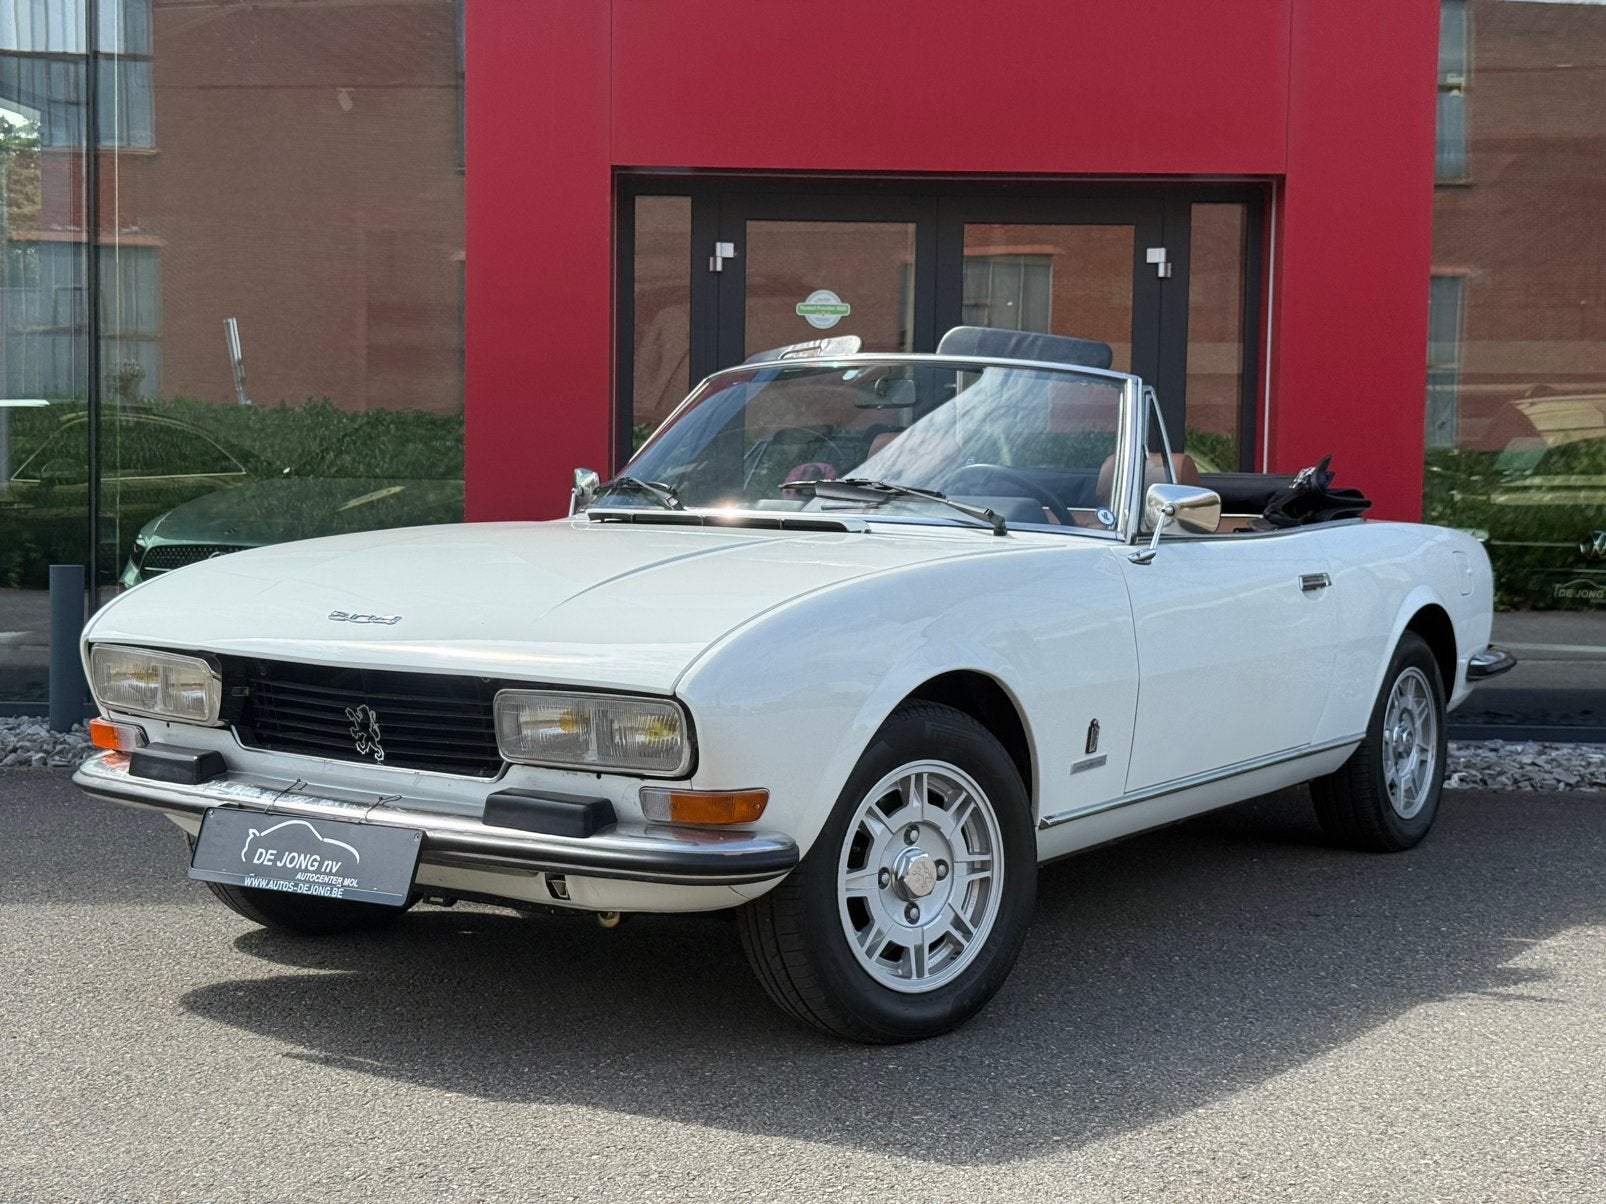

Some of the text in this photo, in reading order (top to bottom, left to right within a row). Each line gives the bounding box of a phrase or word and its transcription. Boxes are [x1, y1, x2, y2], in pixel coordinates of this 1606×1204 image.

[253, 848, 342, 873] DE JONG nv
[244, 876, 345, 898] WWW.AUTOS-DEJONG.BE
[295, 871, 359, 887] AUTOCENTER MOL
